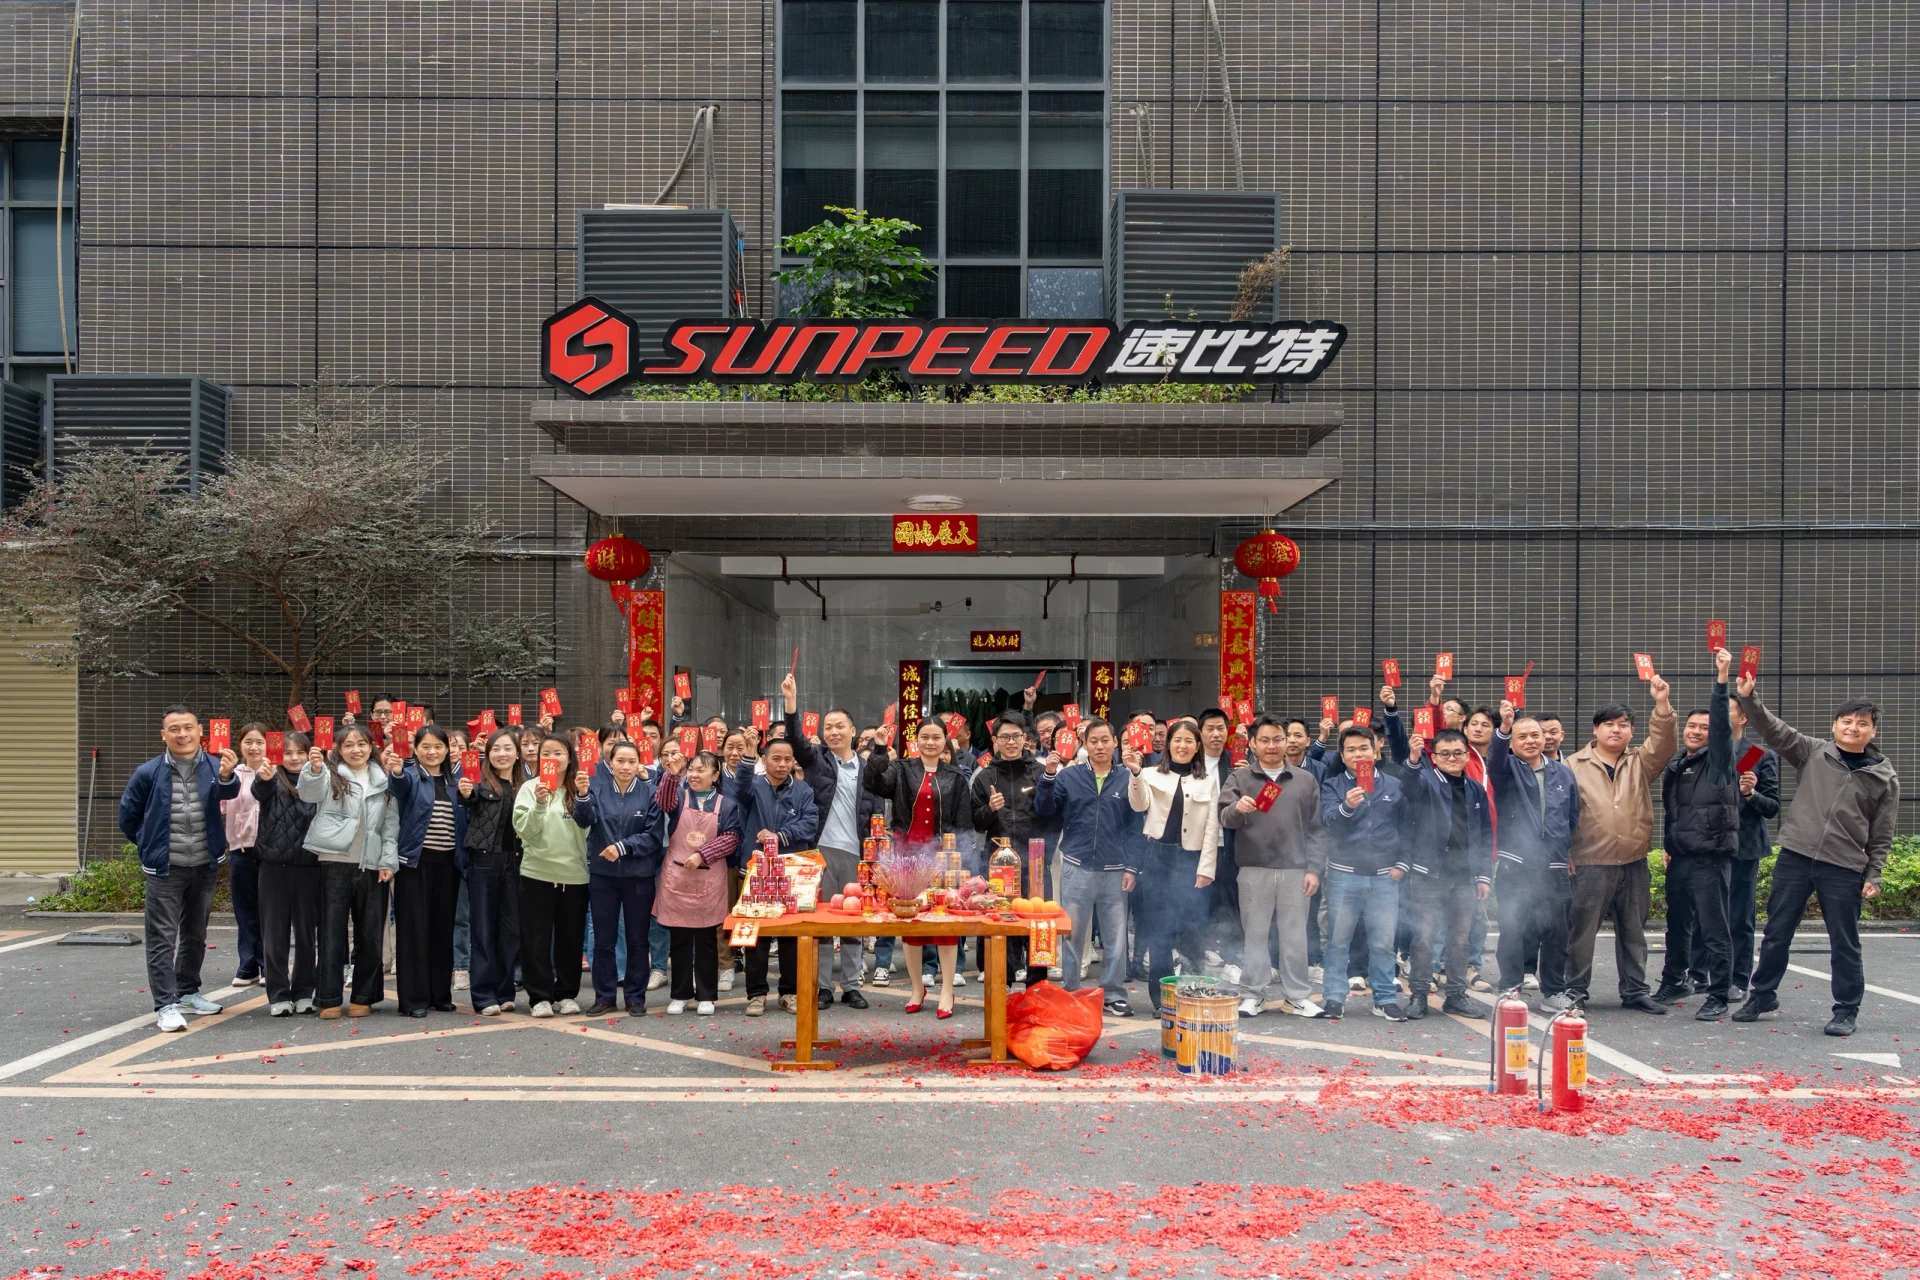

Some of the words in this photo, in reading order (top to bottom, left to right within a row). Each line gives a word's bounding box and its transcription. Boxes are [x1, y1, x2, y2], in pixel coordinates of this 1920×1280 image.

[643, 326, 1111, 376] SUNPEED
[1106, 328, 1334, 375] 速比特
